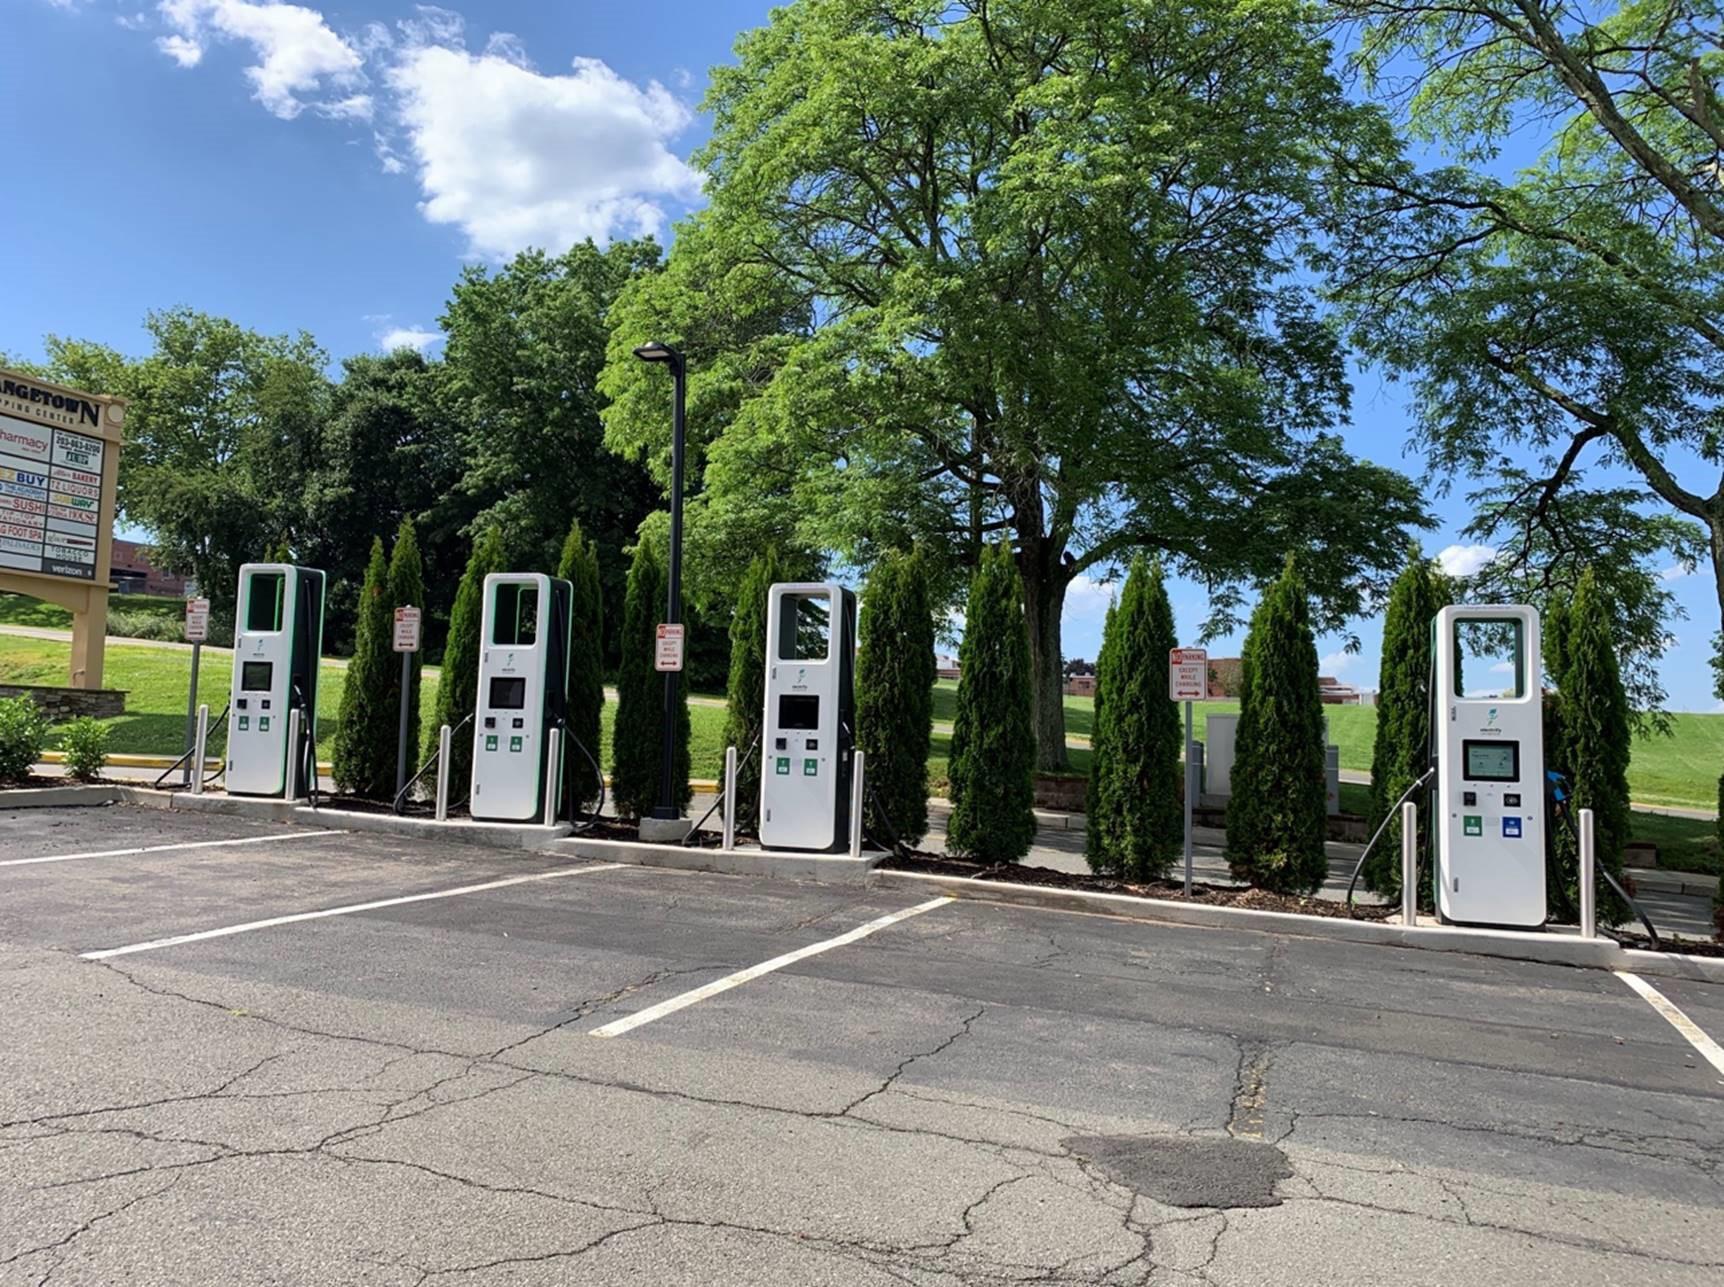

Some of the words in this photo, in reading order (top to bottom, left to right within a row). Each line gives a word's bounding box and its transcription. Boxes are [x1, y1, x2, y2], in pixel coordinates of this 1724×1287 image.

[36, 408, 74, 424] CENTER
[16, 472, 46, 486] BUY
[72, 472, 98, 484] BAKERY
[51, 480, 61, 490] TZ
[62, 482, 98, 498] LIQUORS
[13, 496, 46, 512] SUSHI
[7, 526, 28, 537] FOOT
[29, 529, 42, 540] SPA
[51, 545, 89, 557] TOBACCO
[52, 565, 82, 576] verizon
